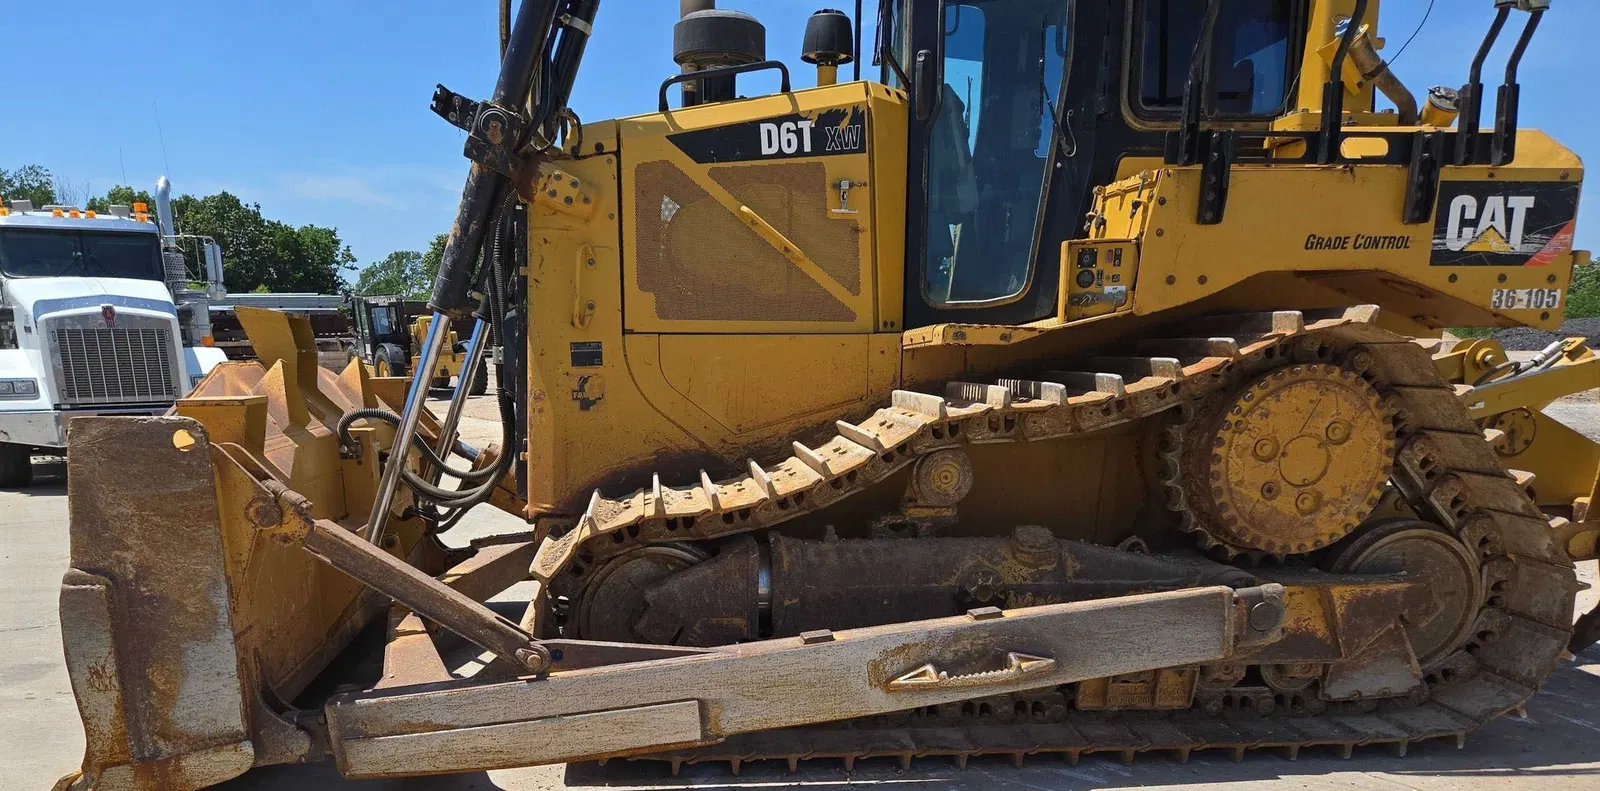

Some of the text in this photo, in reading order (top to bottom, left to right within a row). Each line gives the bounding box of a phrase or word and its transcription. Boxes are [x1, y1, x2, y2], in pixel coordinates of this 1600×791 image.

[759, 121, 861, 156] D6T XW
[1445, 195, 1535, 252] CAT
[1304, 233, 1410, 250] GRADE CONTROL
[1492, 289, 1557, 308] 36-105
